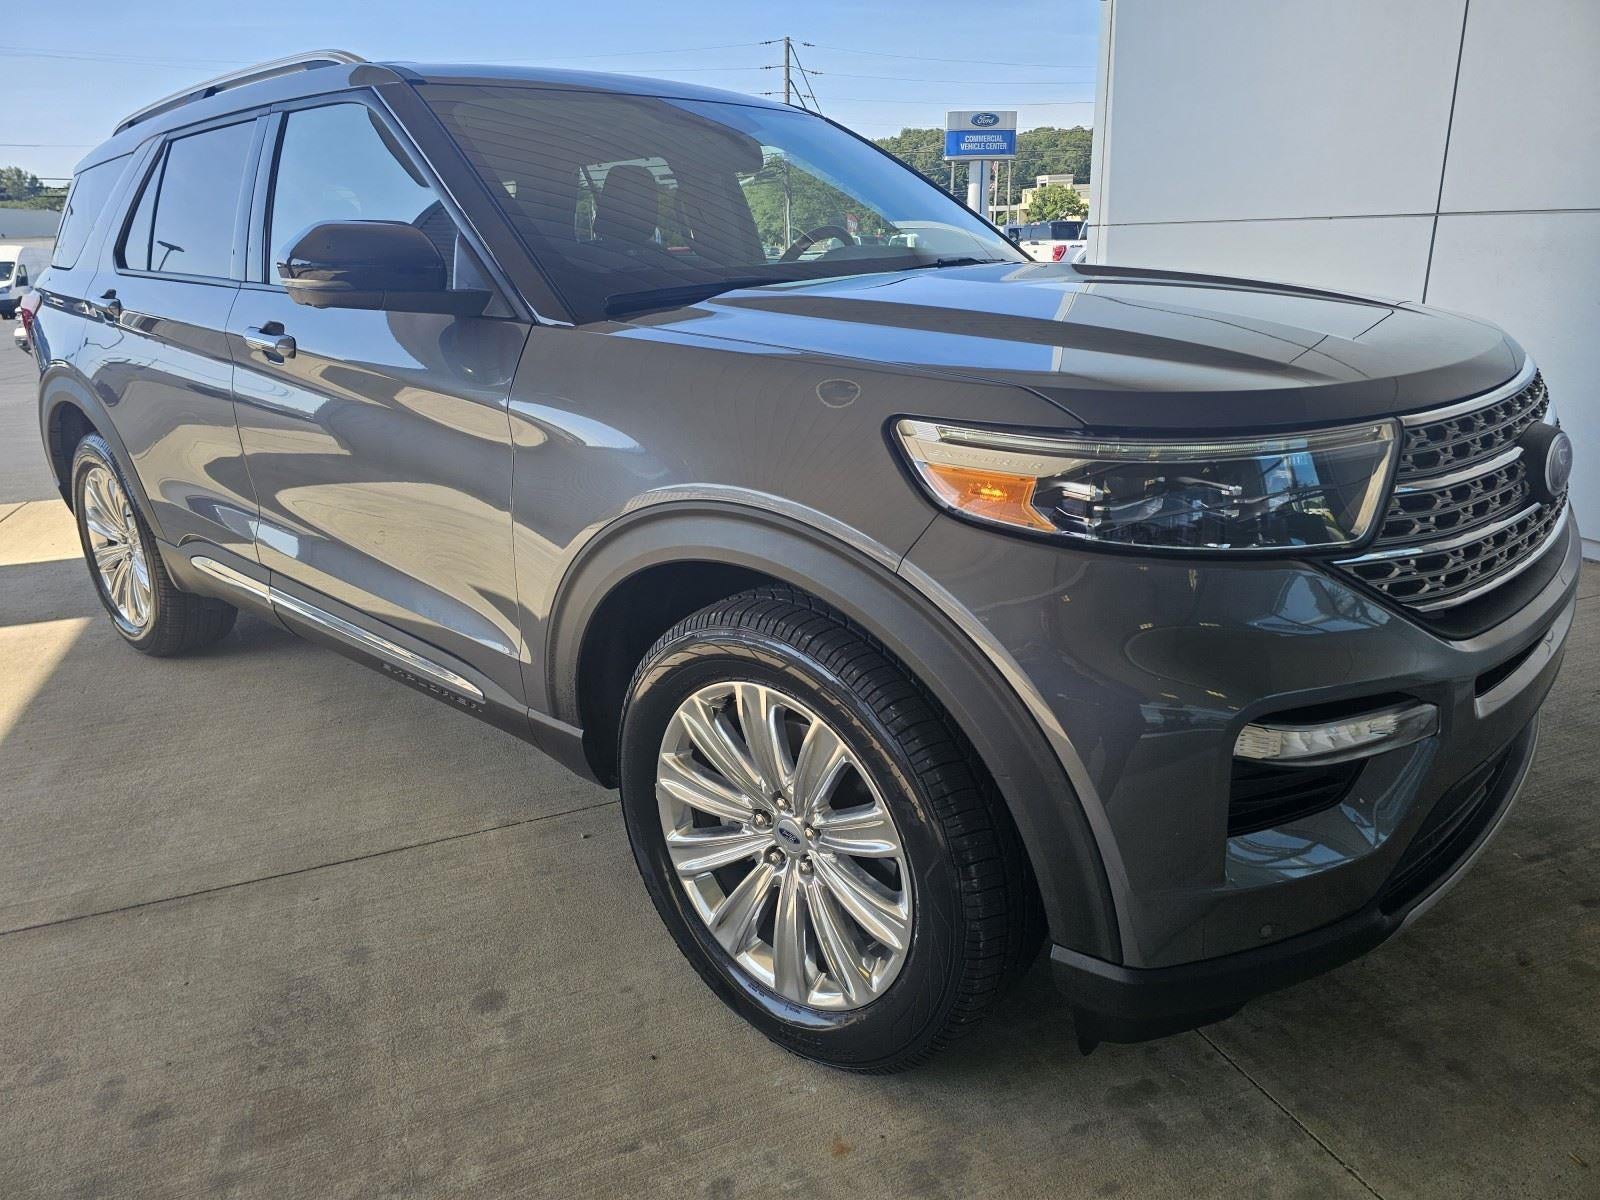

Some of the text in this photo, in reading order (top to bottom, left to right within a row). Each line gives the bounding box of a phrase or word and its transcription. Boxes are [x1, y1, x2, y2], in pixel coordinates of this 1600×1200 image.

[977, 114, 995, 124] Ford
[960, 142, 1007, 150] VEHICLE CENTER
